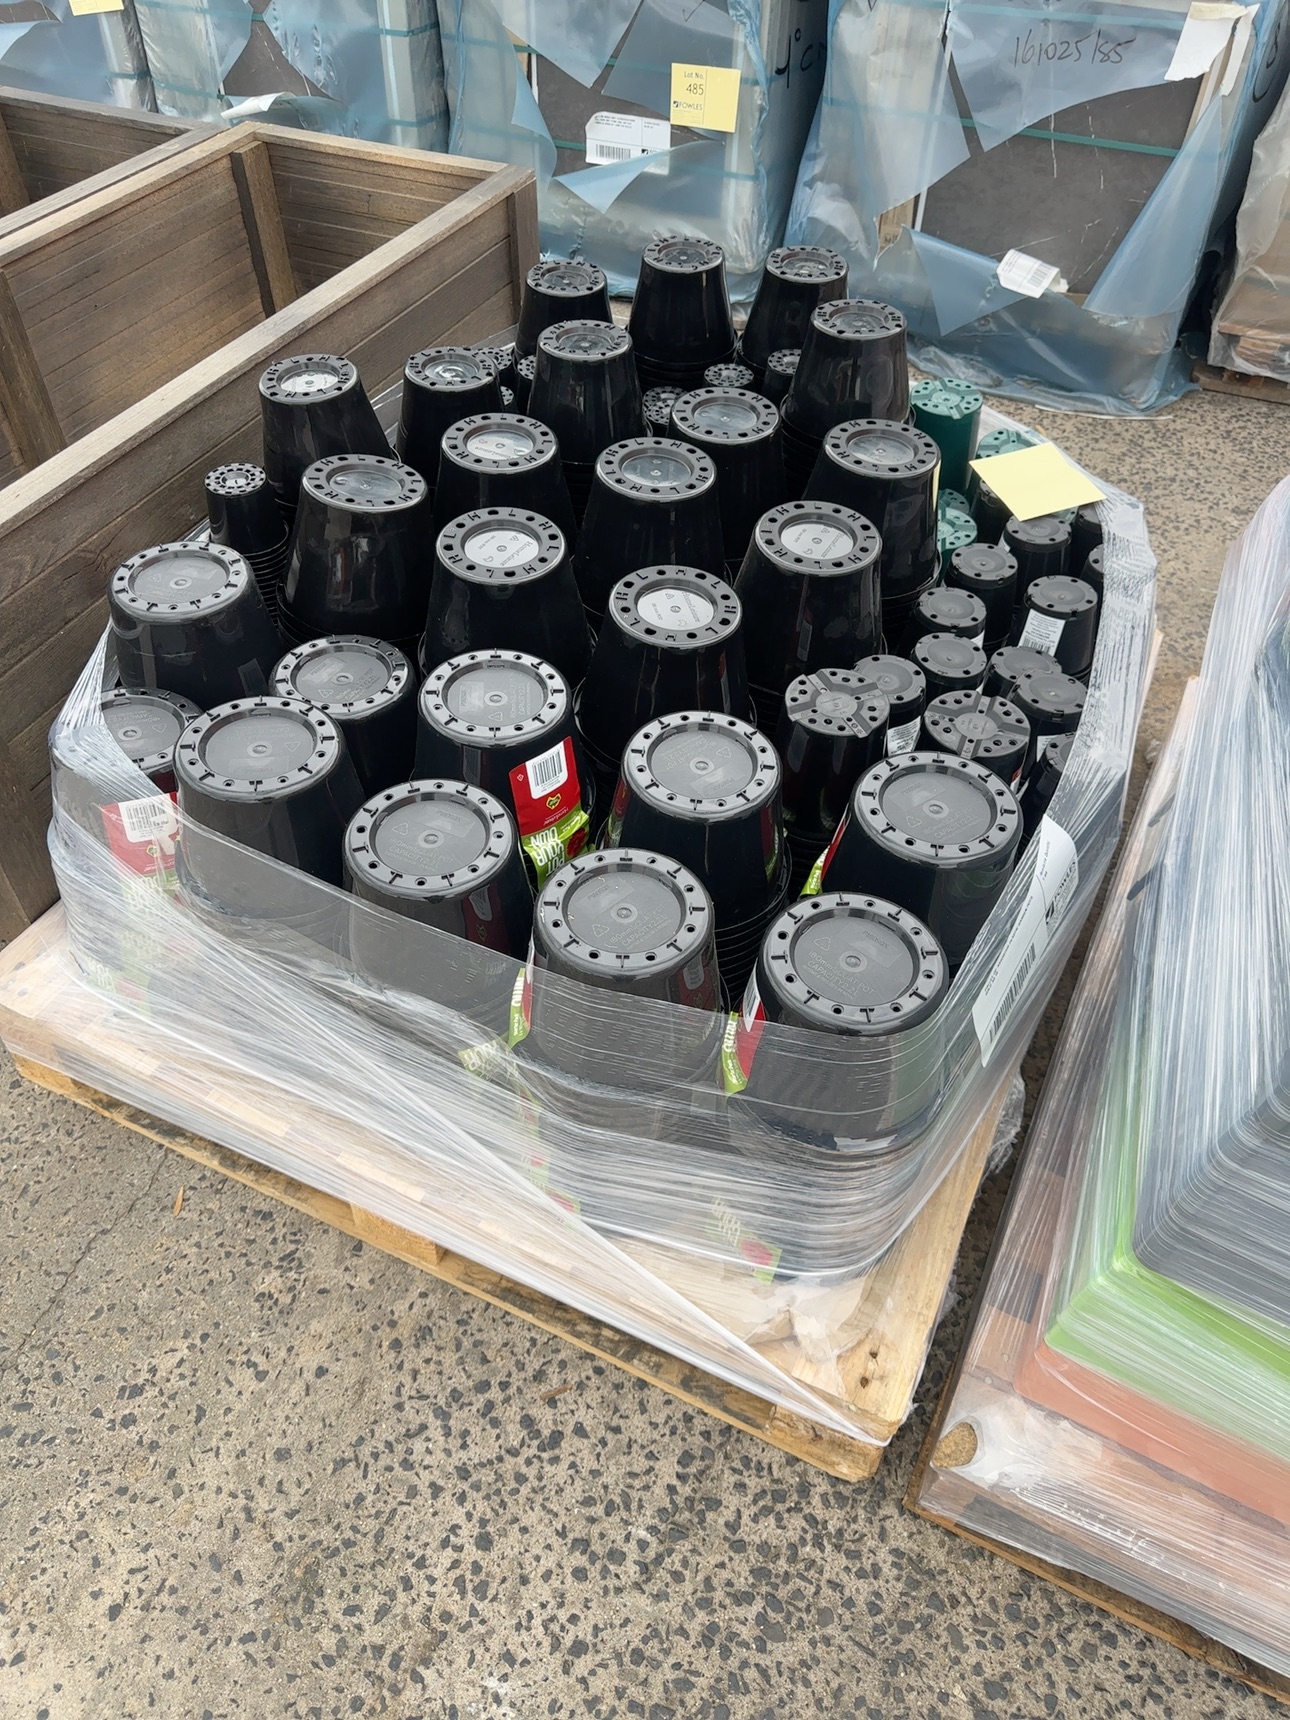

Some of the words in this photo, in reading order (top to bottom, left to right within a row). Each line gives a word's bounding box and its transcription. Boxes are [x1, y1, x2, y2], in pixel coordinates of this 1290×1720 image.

[686, 83, 704, 96] 485
[679, 102, 702, 110] FOWLES
[530, 827, 559, 848] OWN
[533, 840, 564, 865] YOUR
[546, 854, 565, 876] POT
